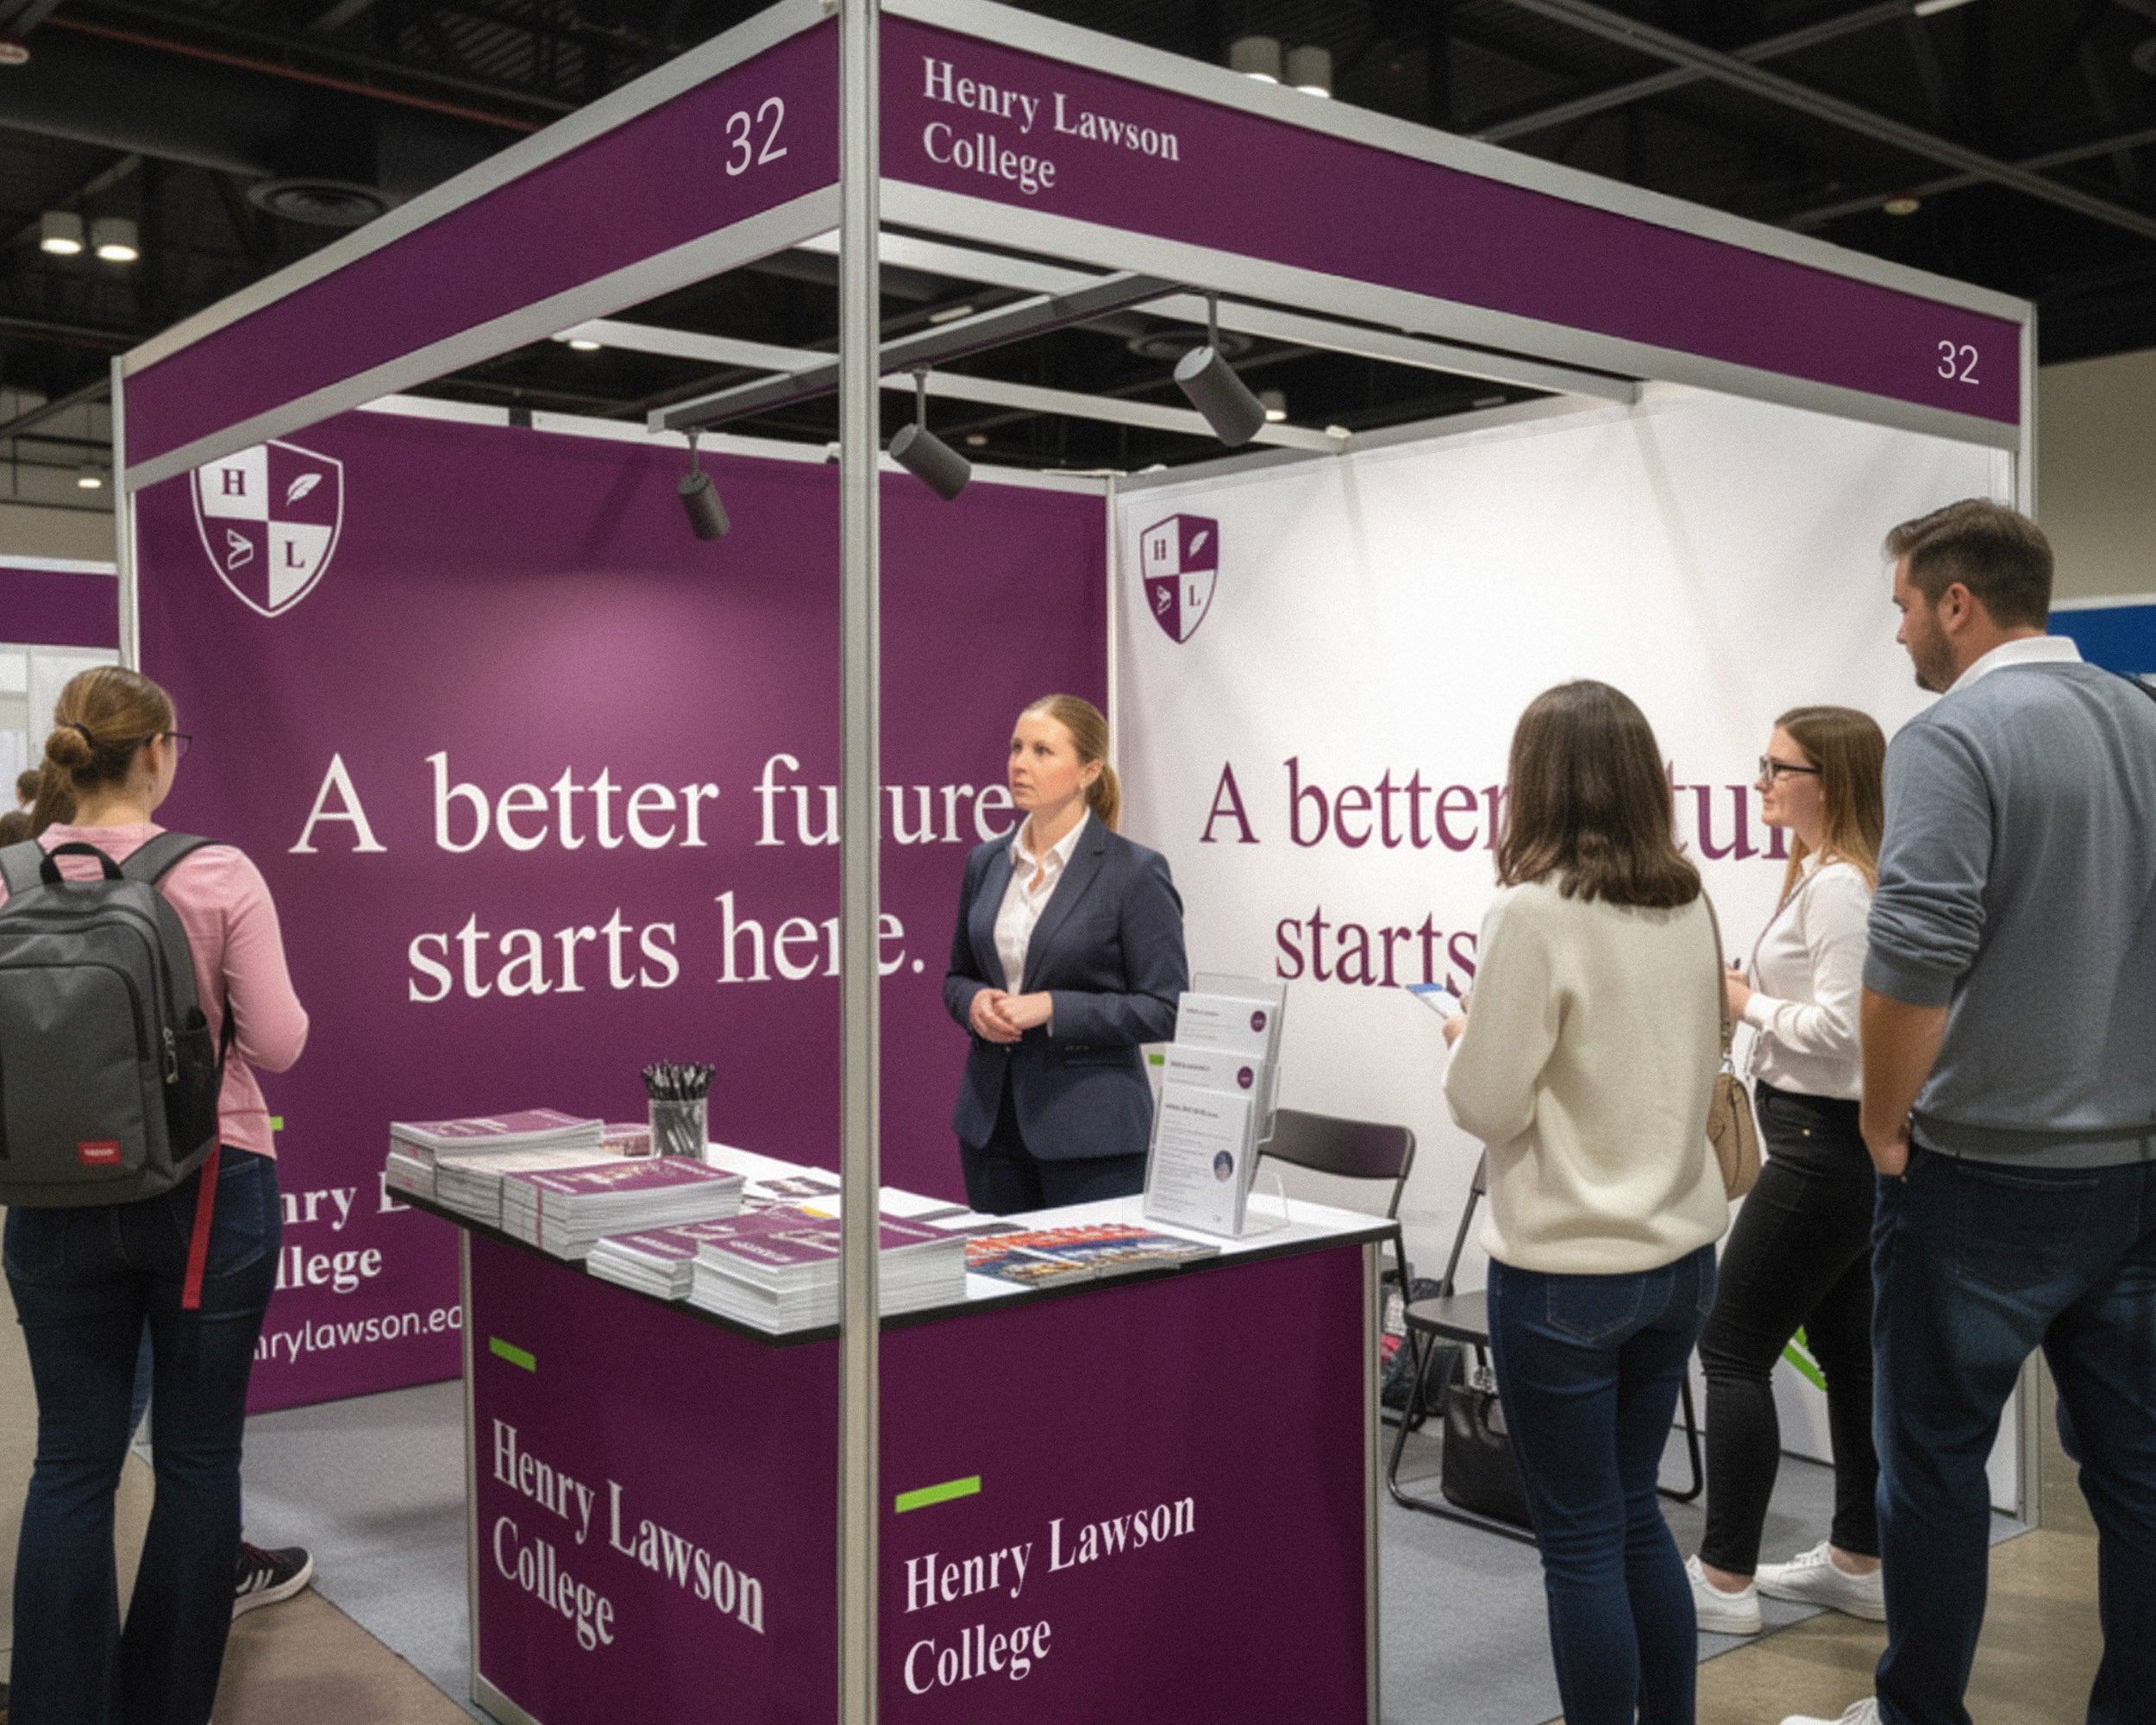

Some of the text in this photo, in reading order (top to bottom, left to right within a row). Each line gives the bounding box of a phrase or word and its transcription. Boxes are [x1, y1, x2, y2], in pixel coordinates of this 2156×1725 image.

[725, 97, 787, 176] 32
[923, 57, 1180, 162] Henry Lawson
[923, 122, 1056, 194] College
[1938, 340, 1980, 385] 32
[222, 467, 247, 497] H
[285, 539, 306, 568] L
[1188, 584, 1201, 606] L
[288, 750, 1016, 854] A better fuure
[1199, 756, 1509, 852] A better
[408, 907, 680, 1002] starts
[1275, 904, 1477, 998] starts
[280, 1187, 357, 1231] nry
[274, 1246, 382, 1294] llege
[493, 1419, 765, 1634] Henry Lawson
[904, 1496, 1197, 1613] Henry Lawson
[493, 1516, 615, 1651] College
[903, 1618, 1053, 1696] College
